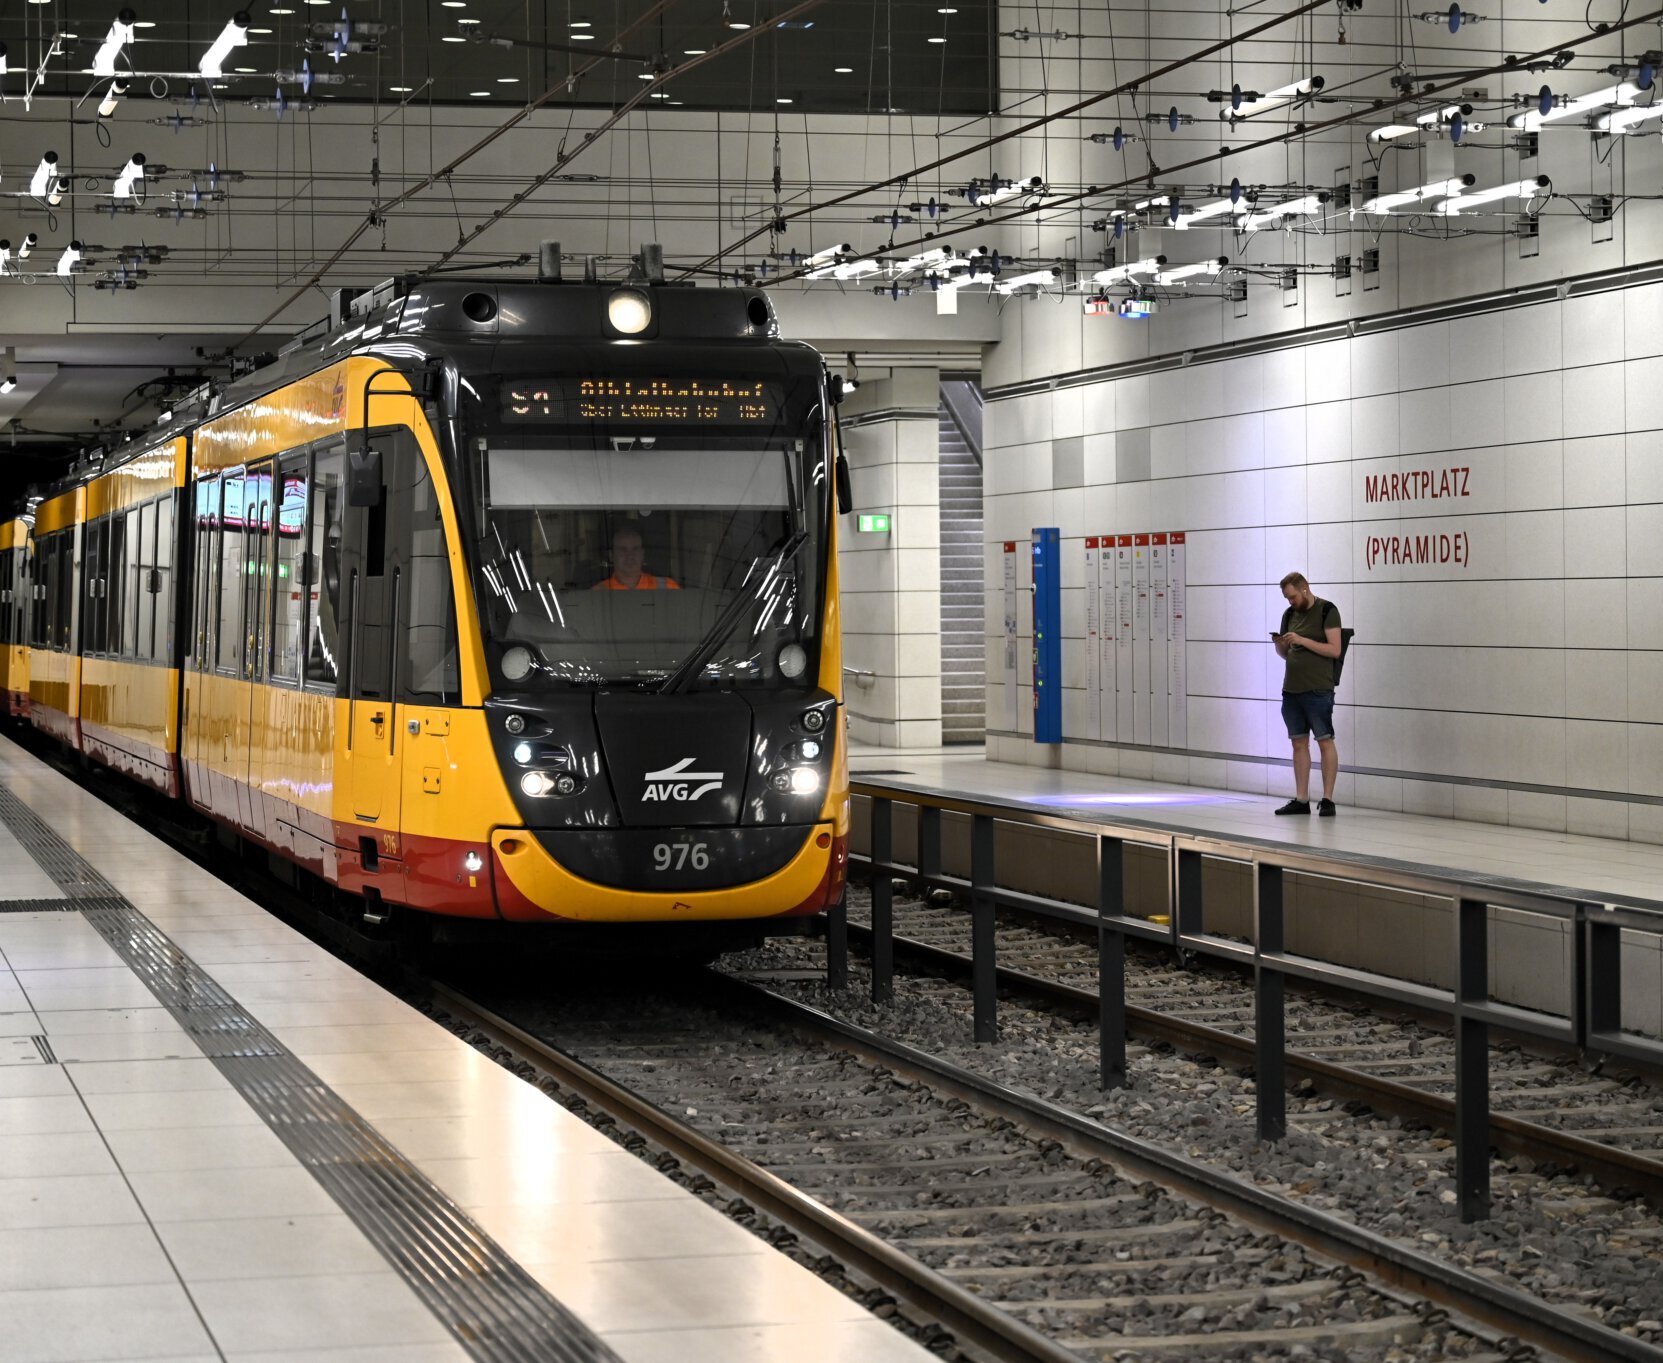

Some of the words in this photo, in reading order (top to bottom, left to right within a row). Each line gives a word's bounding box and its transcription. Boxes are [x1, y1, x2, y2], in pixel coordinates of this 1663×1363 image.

[1365, 467, 1470, 503] MARKTPLATZ
[1366, 531, 1469, 571] (PYRAMIDE)
[641, 783, 689, 801] AVG
[383, 834, 397, 855] 976
[653, 843, 710, 871] 976
